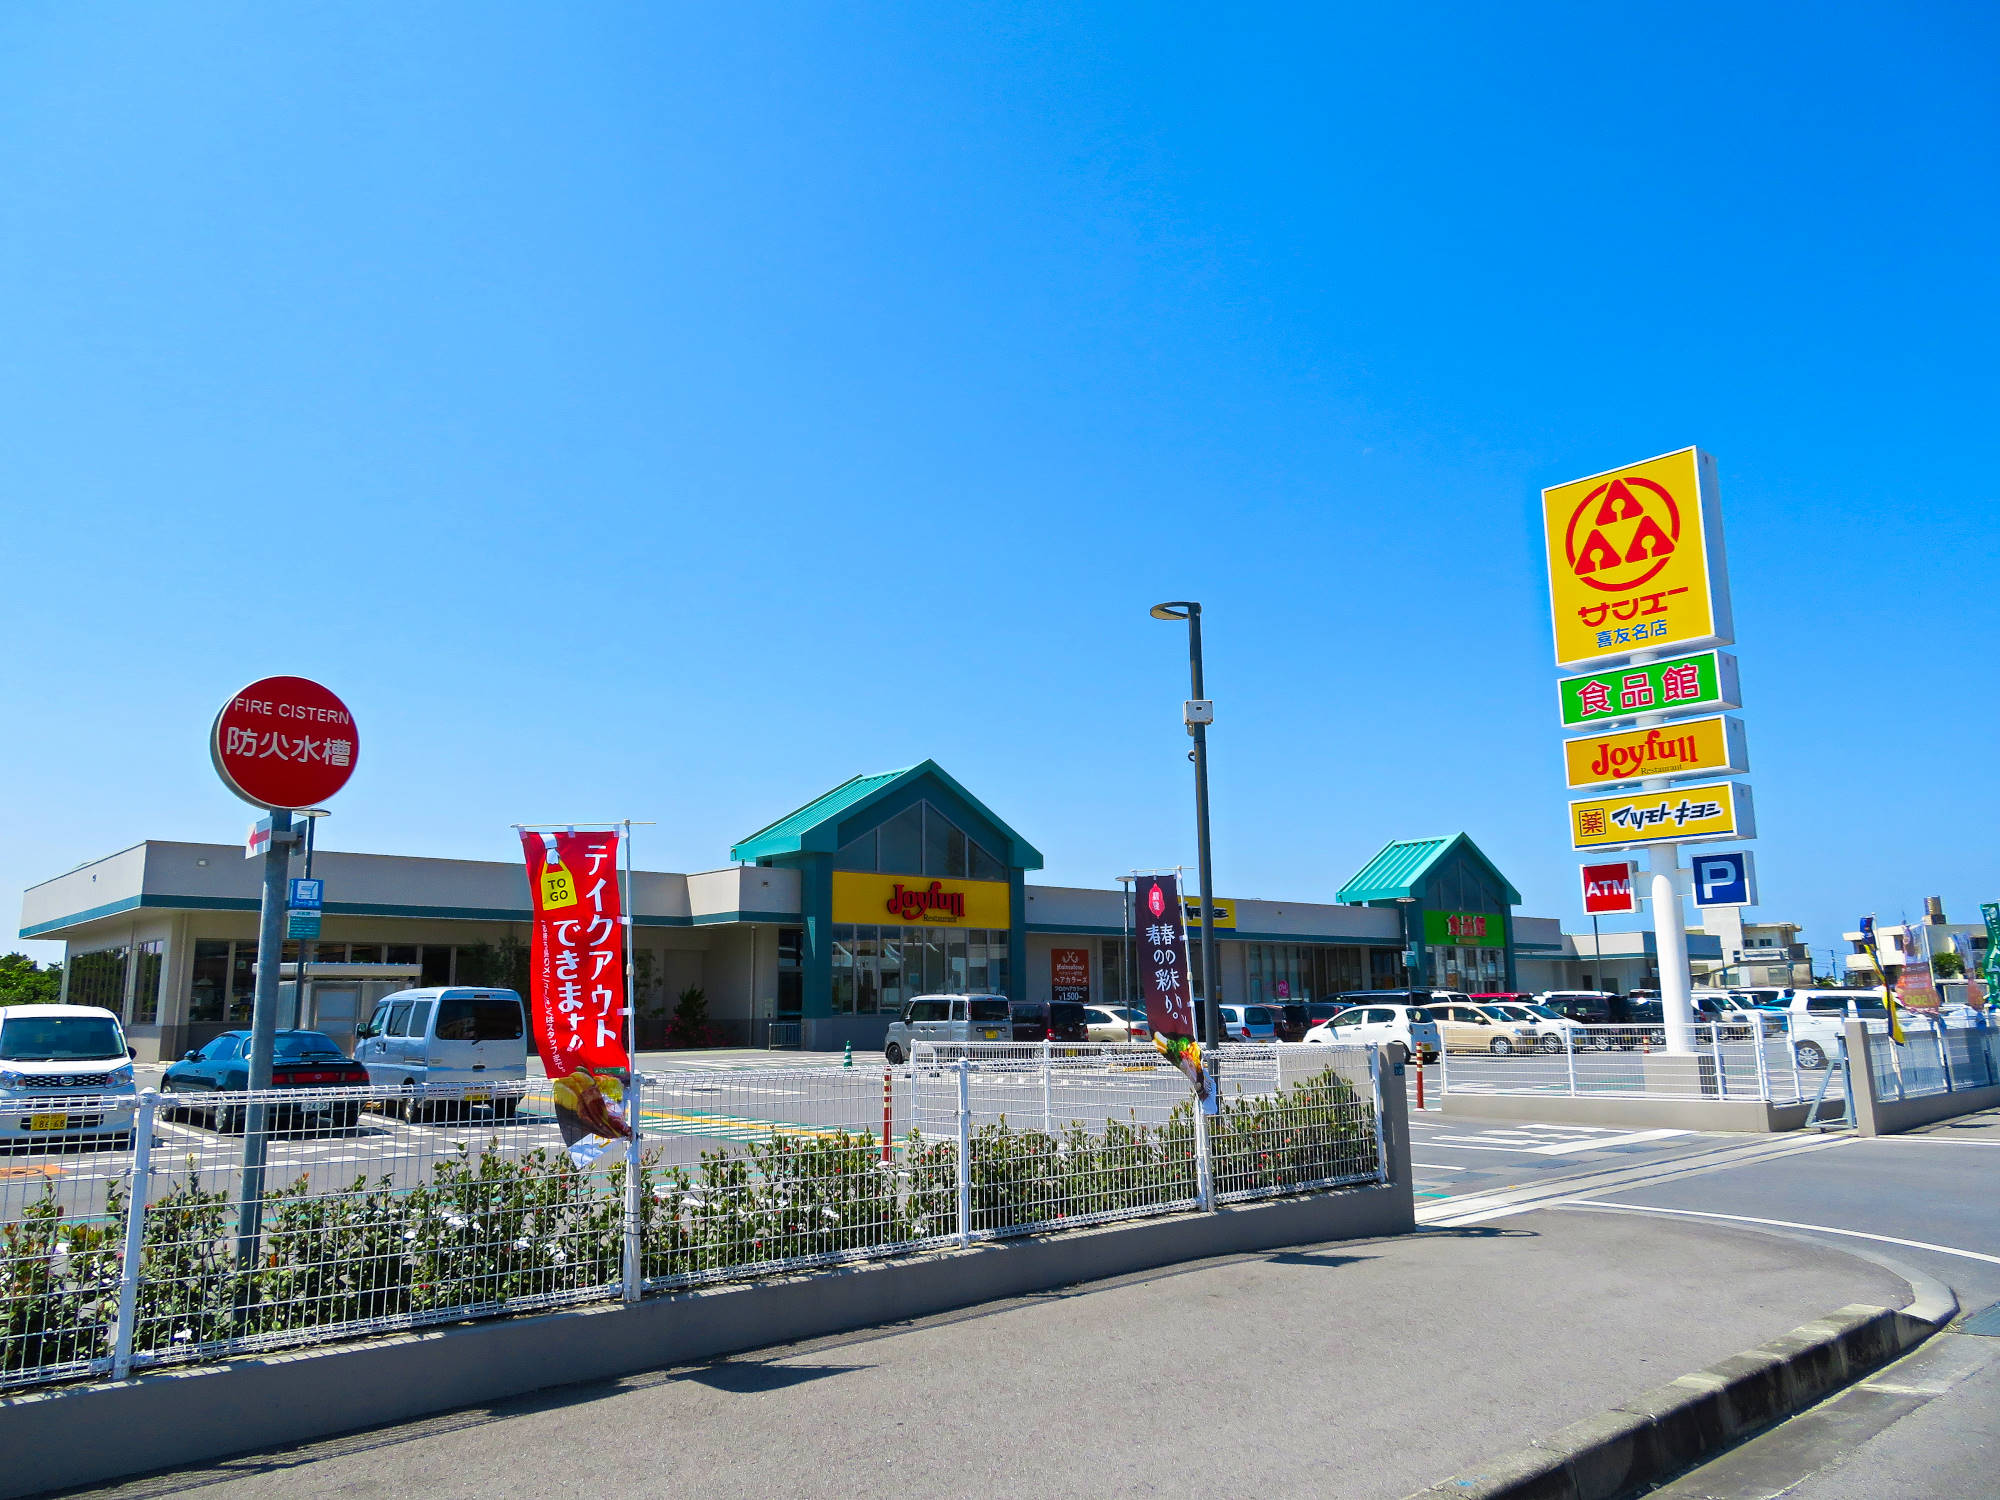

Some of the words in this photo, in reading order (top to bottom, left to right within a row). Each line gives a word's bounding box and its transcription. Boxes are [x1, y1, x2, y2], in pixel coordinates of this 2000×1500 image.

[1578, 587, 1688, 627] サンエー
[1596, 620, 1668, 648] 喜友名店
[1577, 664, 1701, 717] 食品館
[234, 697, 273, 715] FIRE
[278, 703, 349, 725] CISTERN
[226, 726, 352, 767] 防火水槽
[1591, 729, 1699, 778] Joyfull
[548, 878, 567, 890] TO
[549, 889, 569, 902] GO
[1586, 879, 1631, 898] ATM
[1701, 860, 1737, 899] P
[887, 881, 965, 920] Joyfull
[584, 844, 616, 1048] テイクアウト
